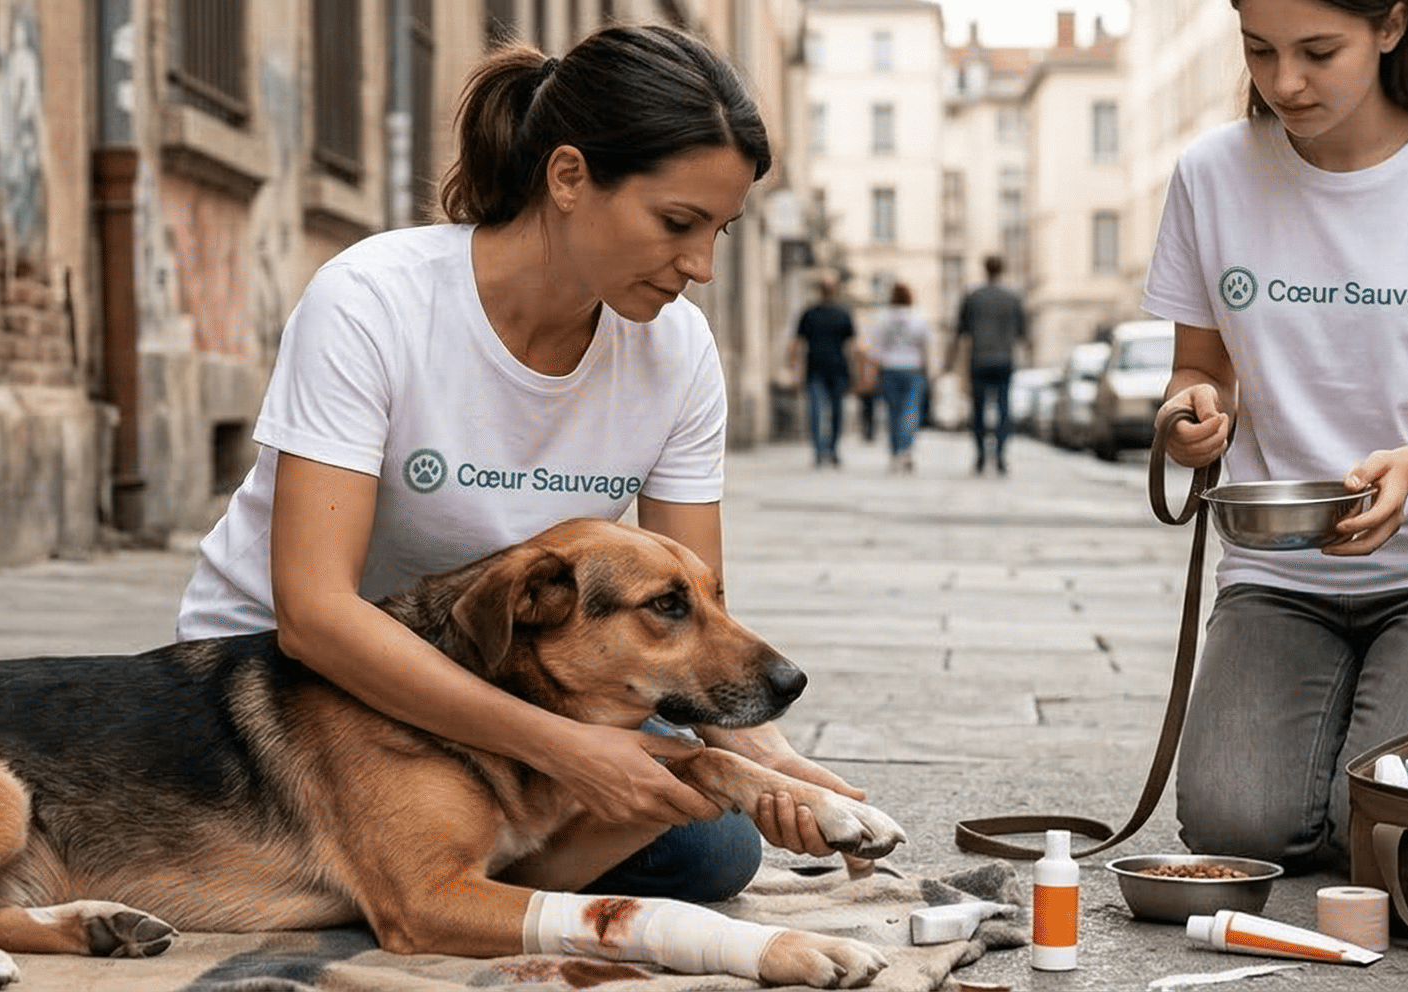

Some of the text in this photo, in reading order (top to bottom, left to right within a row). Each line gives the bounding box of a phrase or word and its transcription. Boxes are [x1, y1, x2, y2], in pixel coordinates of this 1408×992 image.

[1267, 279, 1339, 304] Cœur
[457, 463, 641, 500] Cœur Sauvage
